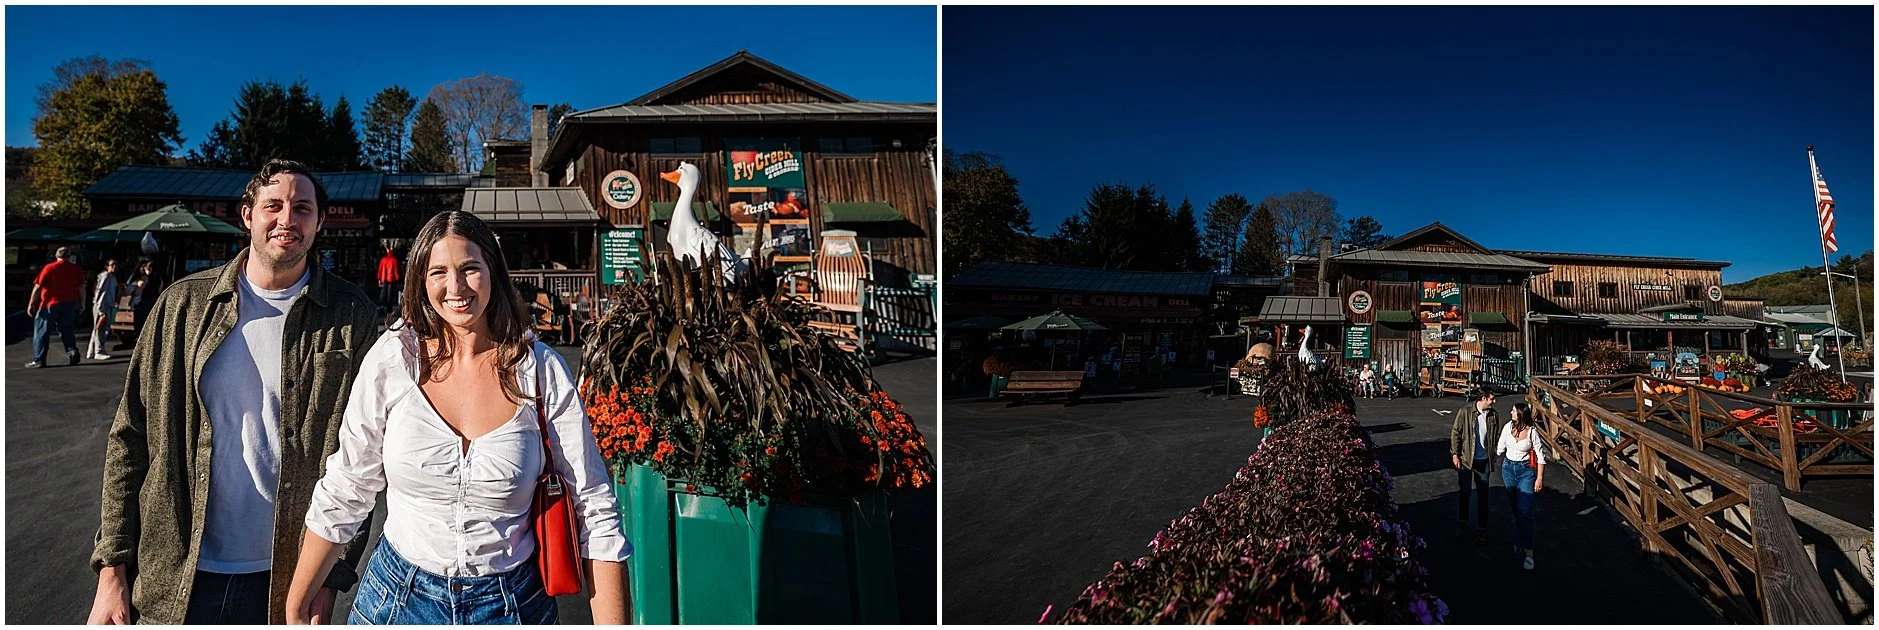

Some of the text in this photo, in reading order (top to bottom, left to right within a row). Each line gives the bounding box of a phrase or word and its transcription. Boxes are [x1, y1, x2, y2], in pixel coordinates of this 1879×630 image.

[733, 144, 794, 181] Fly Creek
[328, 206, 354, 215] DELI
[743, 201, 775, 215] Taste
[1424, 287, 1436, 299] Fly
[1051, 293, 1082, 306] ICE
[1090, 294, 1158, 308] CREAM
